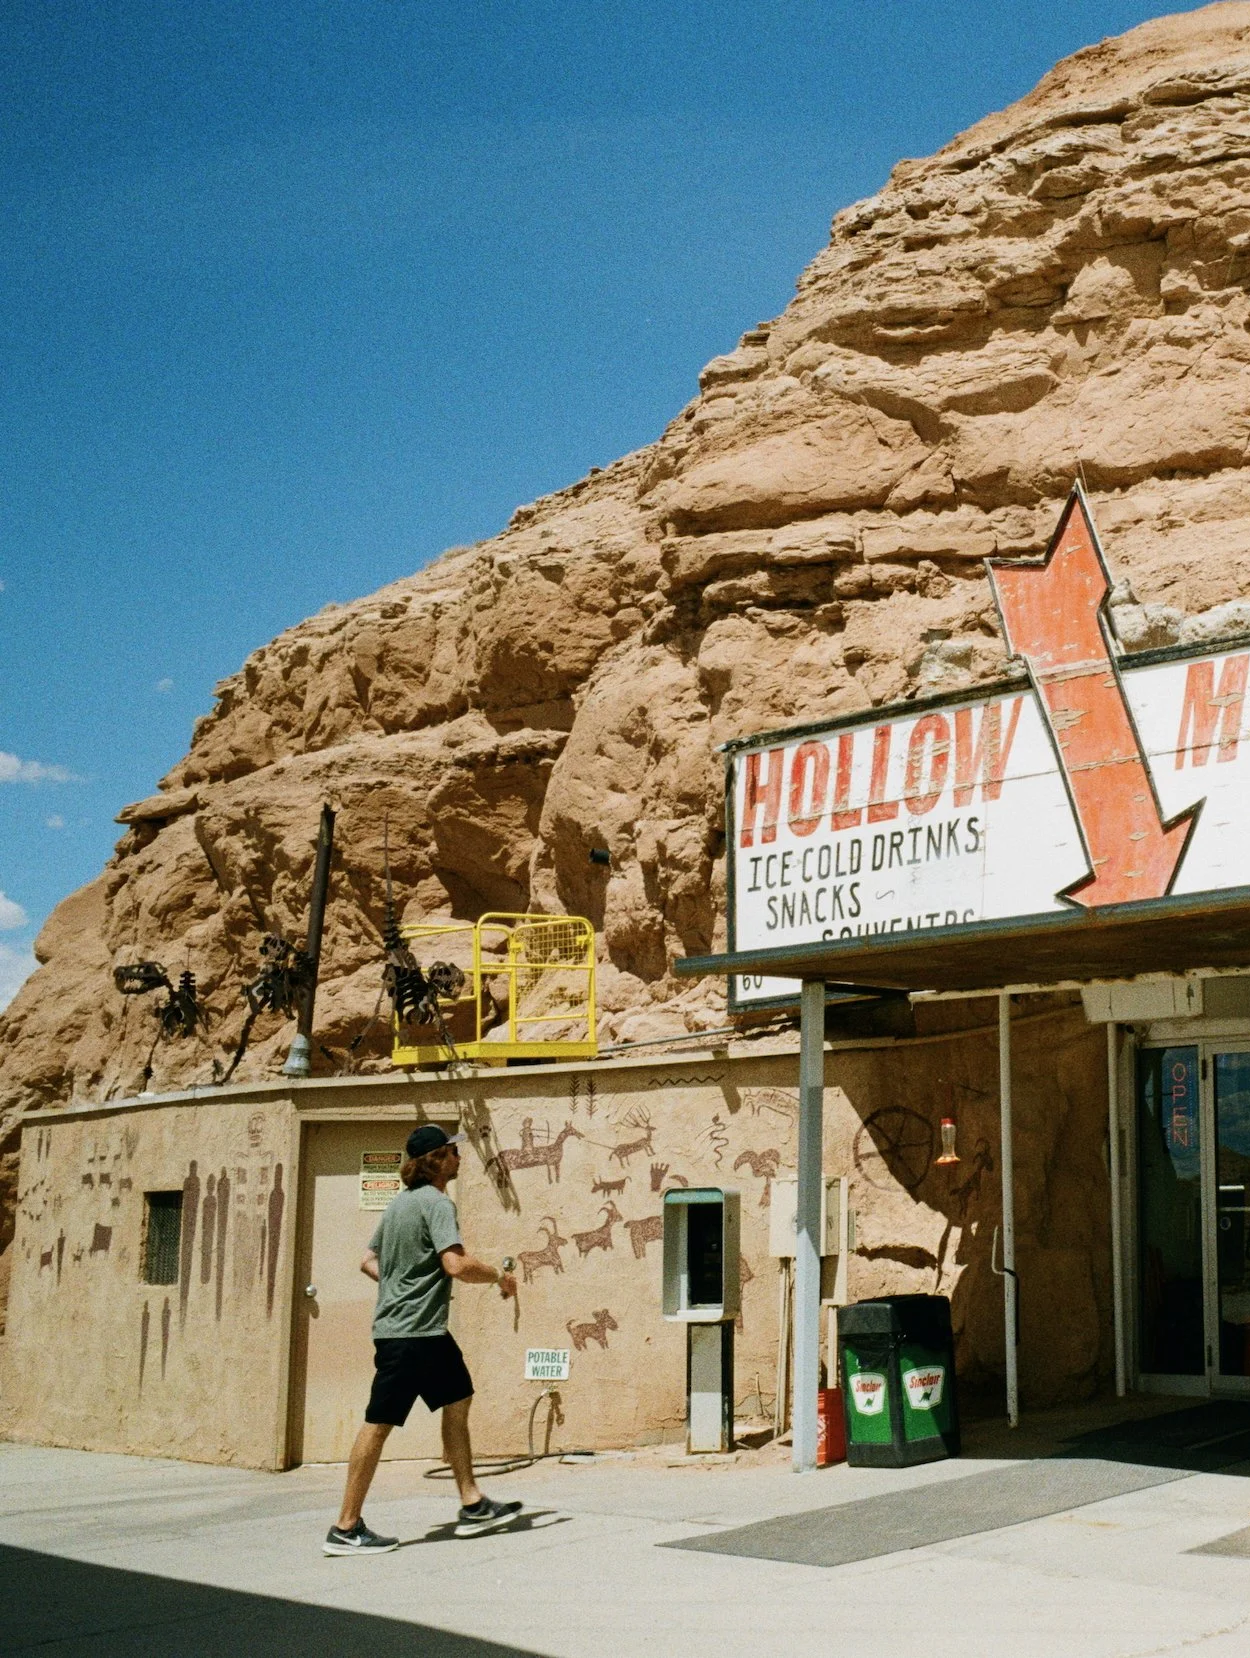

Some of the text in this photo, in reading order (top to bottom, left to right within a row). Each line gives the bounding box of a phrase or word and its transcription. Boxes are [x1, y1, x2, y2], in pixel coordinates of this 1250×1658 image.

[740, 696, 1024, 848] HOLLOW
[747, 816, 981, 892] ICE COLD DRINKS
[766, 882, 862, 930] SNACKS
[1172, 1063, 1188, 1147] OPEN
[528, 1351, 568, 1363] POTABLE
[532, 1365, 562, 1377] WATER
[855, 1380, 882, 1393] Sinclair
[909, 1372, 941, 1389] Sinclair
